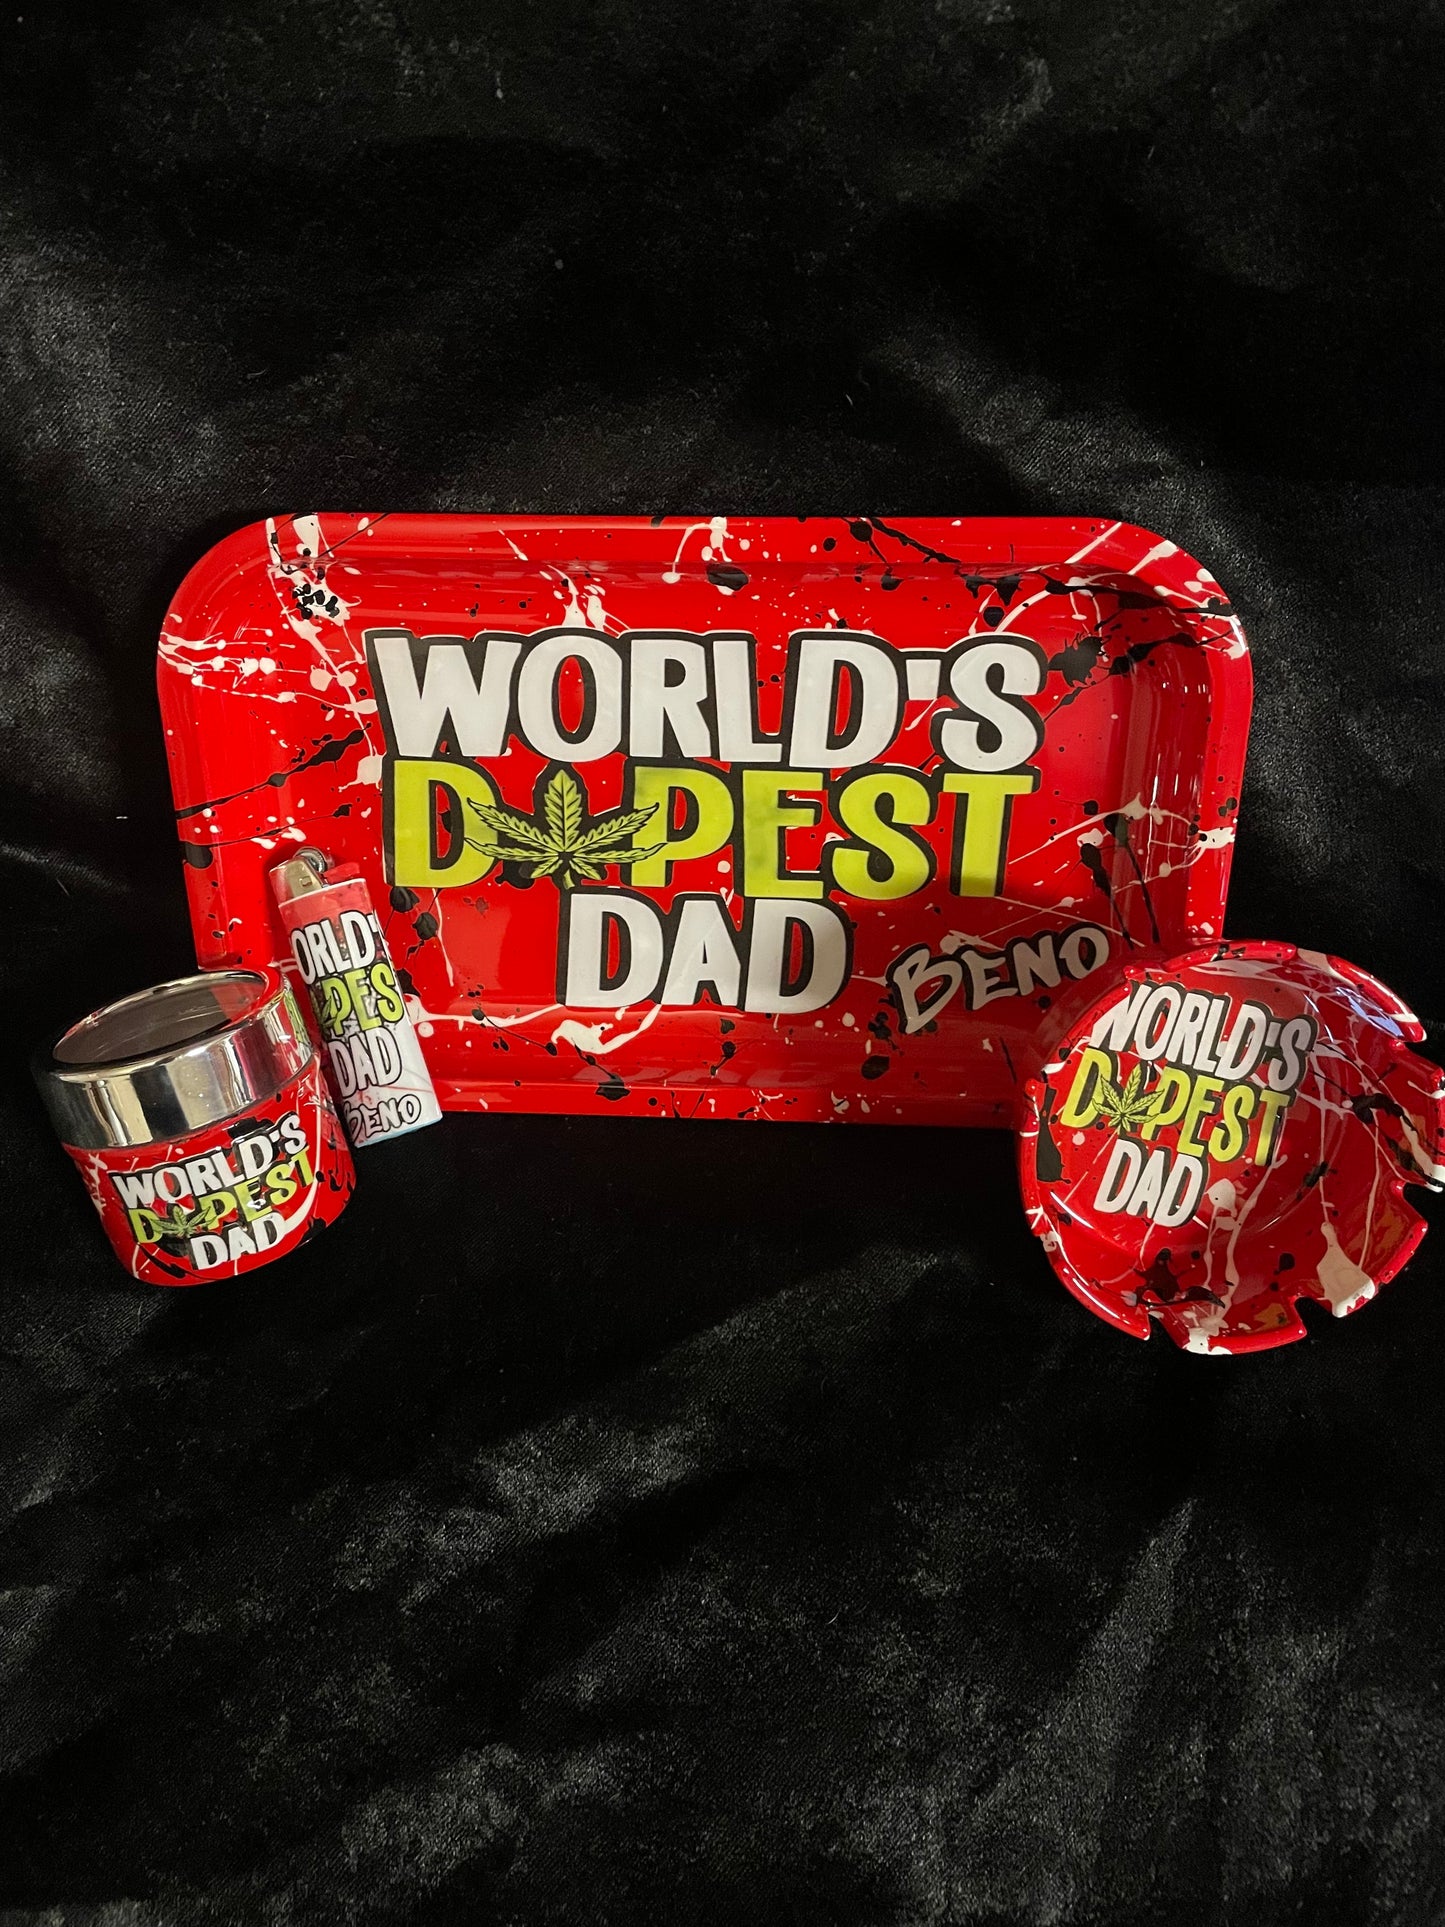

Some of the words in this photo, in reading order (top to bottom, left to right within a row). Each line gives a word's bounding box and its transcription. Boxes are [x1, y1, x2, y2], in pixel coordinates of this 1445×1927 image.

[372, 634, 1040, 772] WORLD'S
[392, 760, 1035, 900] DPEST
[563, 894, 847, 1014] DAD
[893, 927, 1110, 1034] BENO
[329, 1027, 403, 1098] DAD
[1060, 1049, 1290, 1166] DPEST
[111, 1113, 306, 1209] WORLD'S
[1093, 1139, 1204, 1227] DAD
[190, 1211, 287, 1270] DAD
